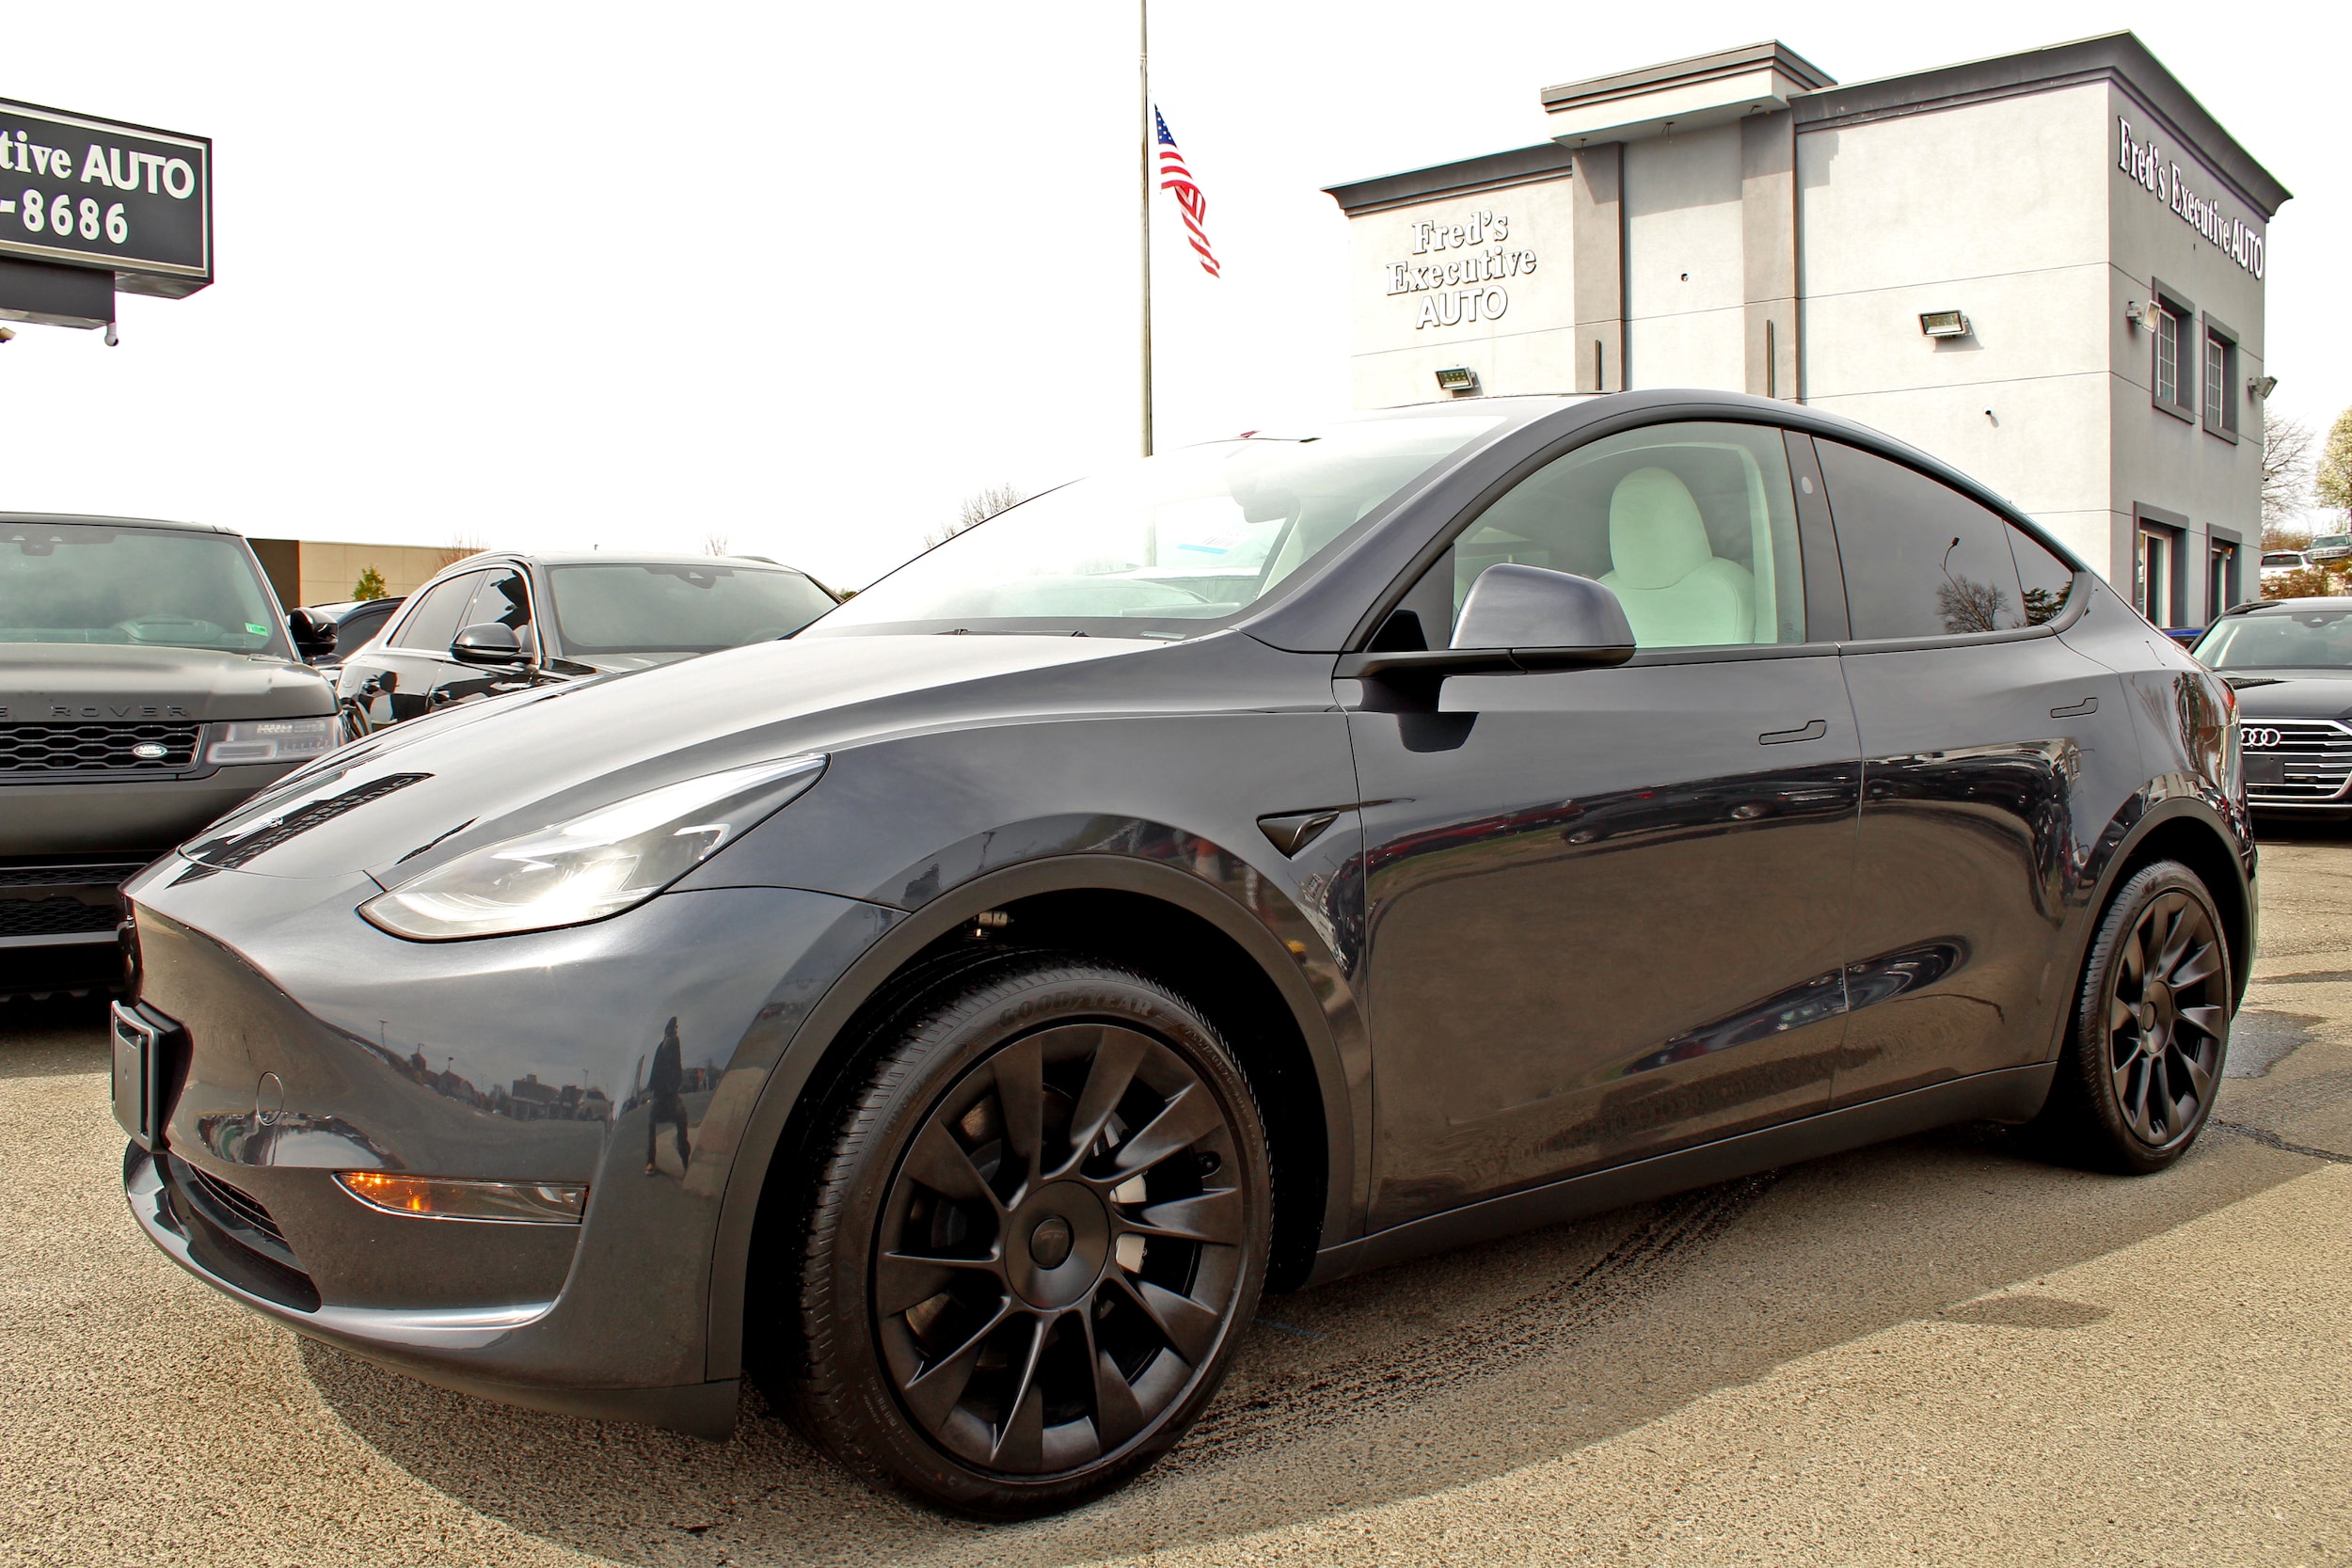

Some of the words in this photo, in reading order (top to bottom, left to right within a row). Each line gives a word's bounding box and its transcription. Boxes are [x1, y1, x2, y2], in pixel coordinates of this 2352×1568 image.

[81, 144, 196, 199] AUTO
[2118, 115, 2166, 201] Fred's
[2169, 160, 2230, 253] Executive
[2231, 217, 2264, 280] AUTO
[1412, 210, 1509, 255] Fred's
[1386, 245, 1537, 295] Executive
[1415, 284, 1509, 329] AUTO
[51, 705, 187, 718] ROVER
